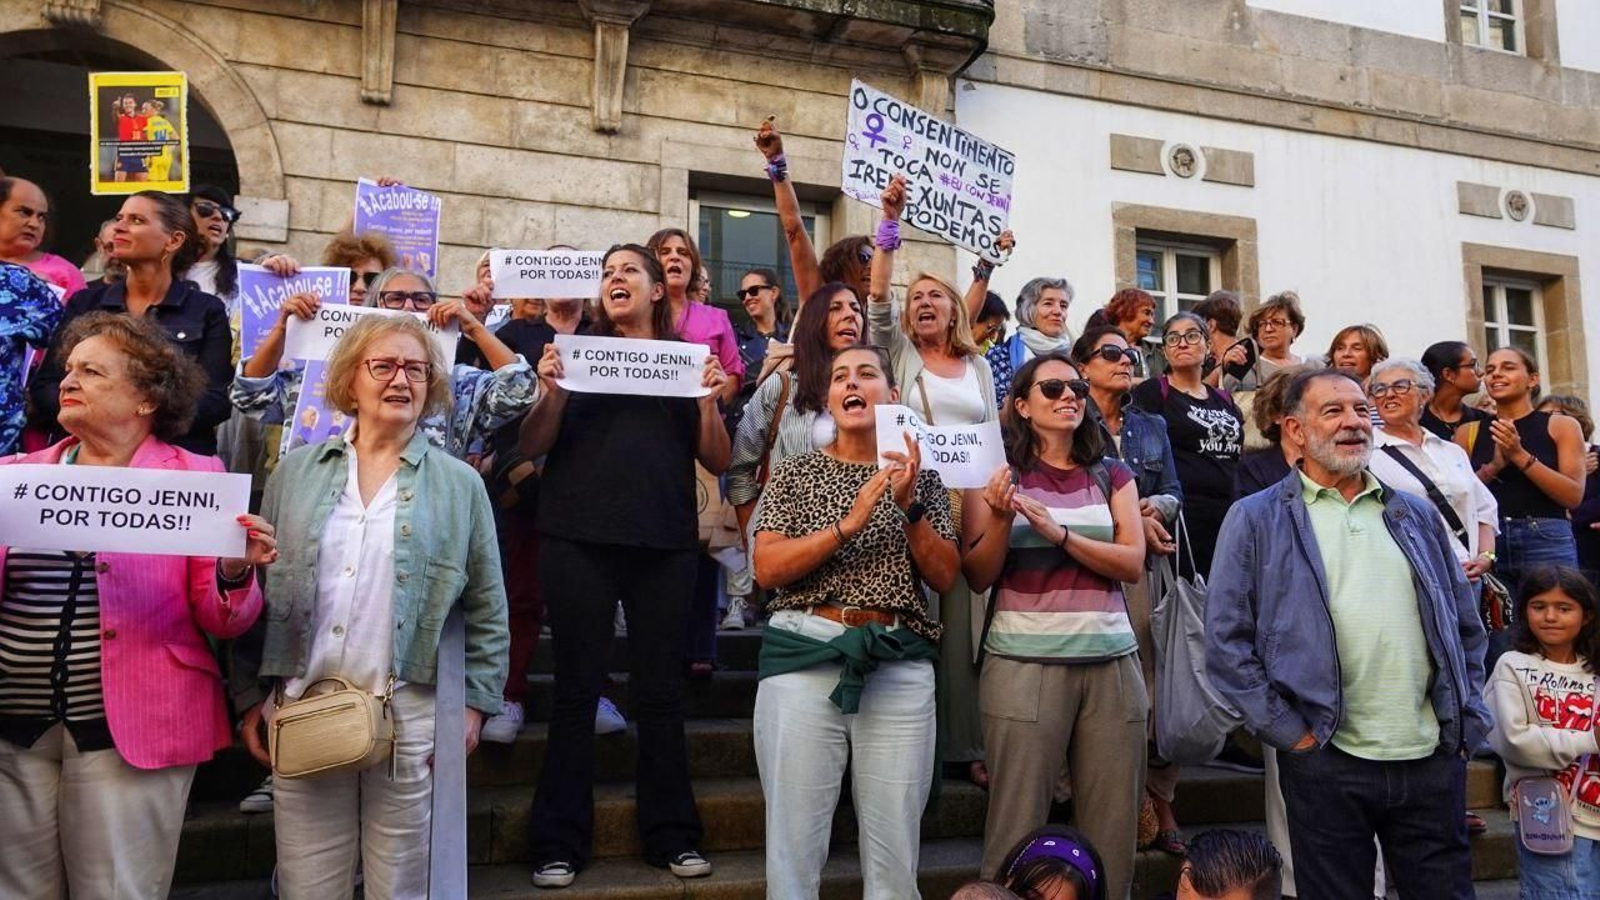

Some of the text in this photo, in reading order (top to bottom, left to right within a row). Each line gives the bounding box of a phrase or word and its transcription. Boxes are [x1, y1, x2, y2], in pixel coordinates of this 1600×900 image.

[853, 87, 869, 110] O
[878, 148, 934, 183] TOCA
[925, 146, 1001, 195] NON SE
[917, 184, 1002, 237] XUNTAS
[905, 203, 1001, 259] PODEMOS
[504, 256, 512, 265] #
[515, 255, 571, 266] CONTIGO
[520, 269, 599, 280] POR TODAS!!
[324, 326, 345, 338] PO
[572, 349, 695, 368] # CONTIGO JENNI,
[590, 365, 678, 380] POR TODAS!!
[896, 414, 905, 426] #
[14, 483, 220, 511] # CONTIGO JENNI,
[40, 508, 191, 530] POR TODAS!!
